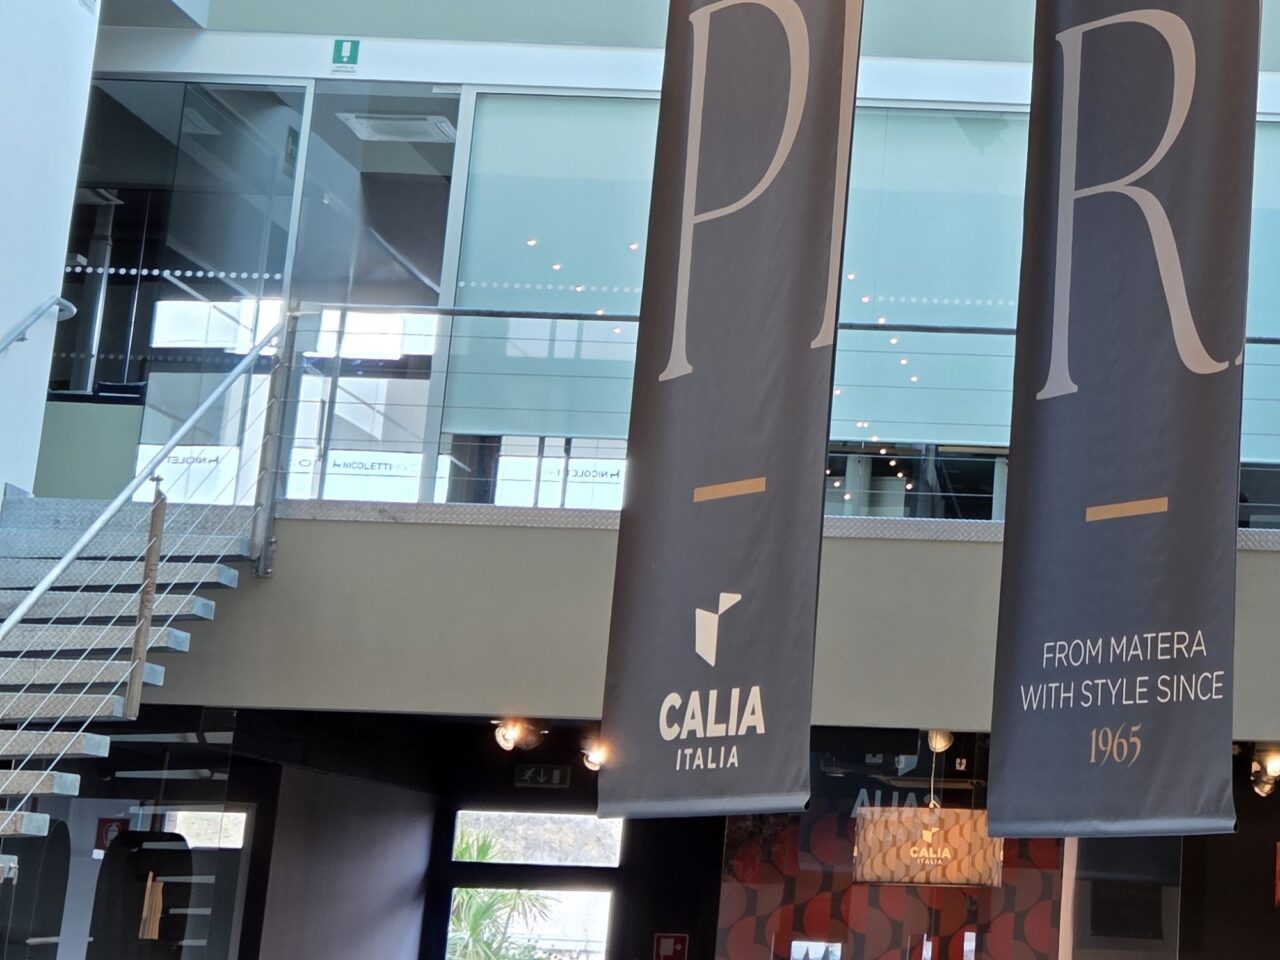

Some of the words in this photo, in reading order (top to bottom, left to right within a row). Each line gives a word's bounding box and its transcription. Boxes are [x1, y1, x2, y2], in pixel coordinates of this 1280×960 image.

[342, 461, 392, 471] NICOLETTI
[1043, 638, 1102, 669] FROM
[1110, 630, 1207, 663] MATERA
[1021, 682, 1074, 711] WITH
[1080, 676, 1149, 707] STYLE
[1157, 671, 1224, 703] SINCE
[659, 685, 765, 741] CALIA
[676, 745, 738, 771] ITALIA
[1090, 722, 1142, 768] 1965
[909, 846, 952, 859] CALIA
